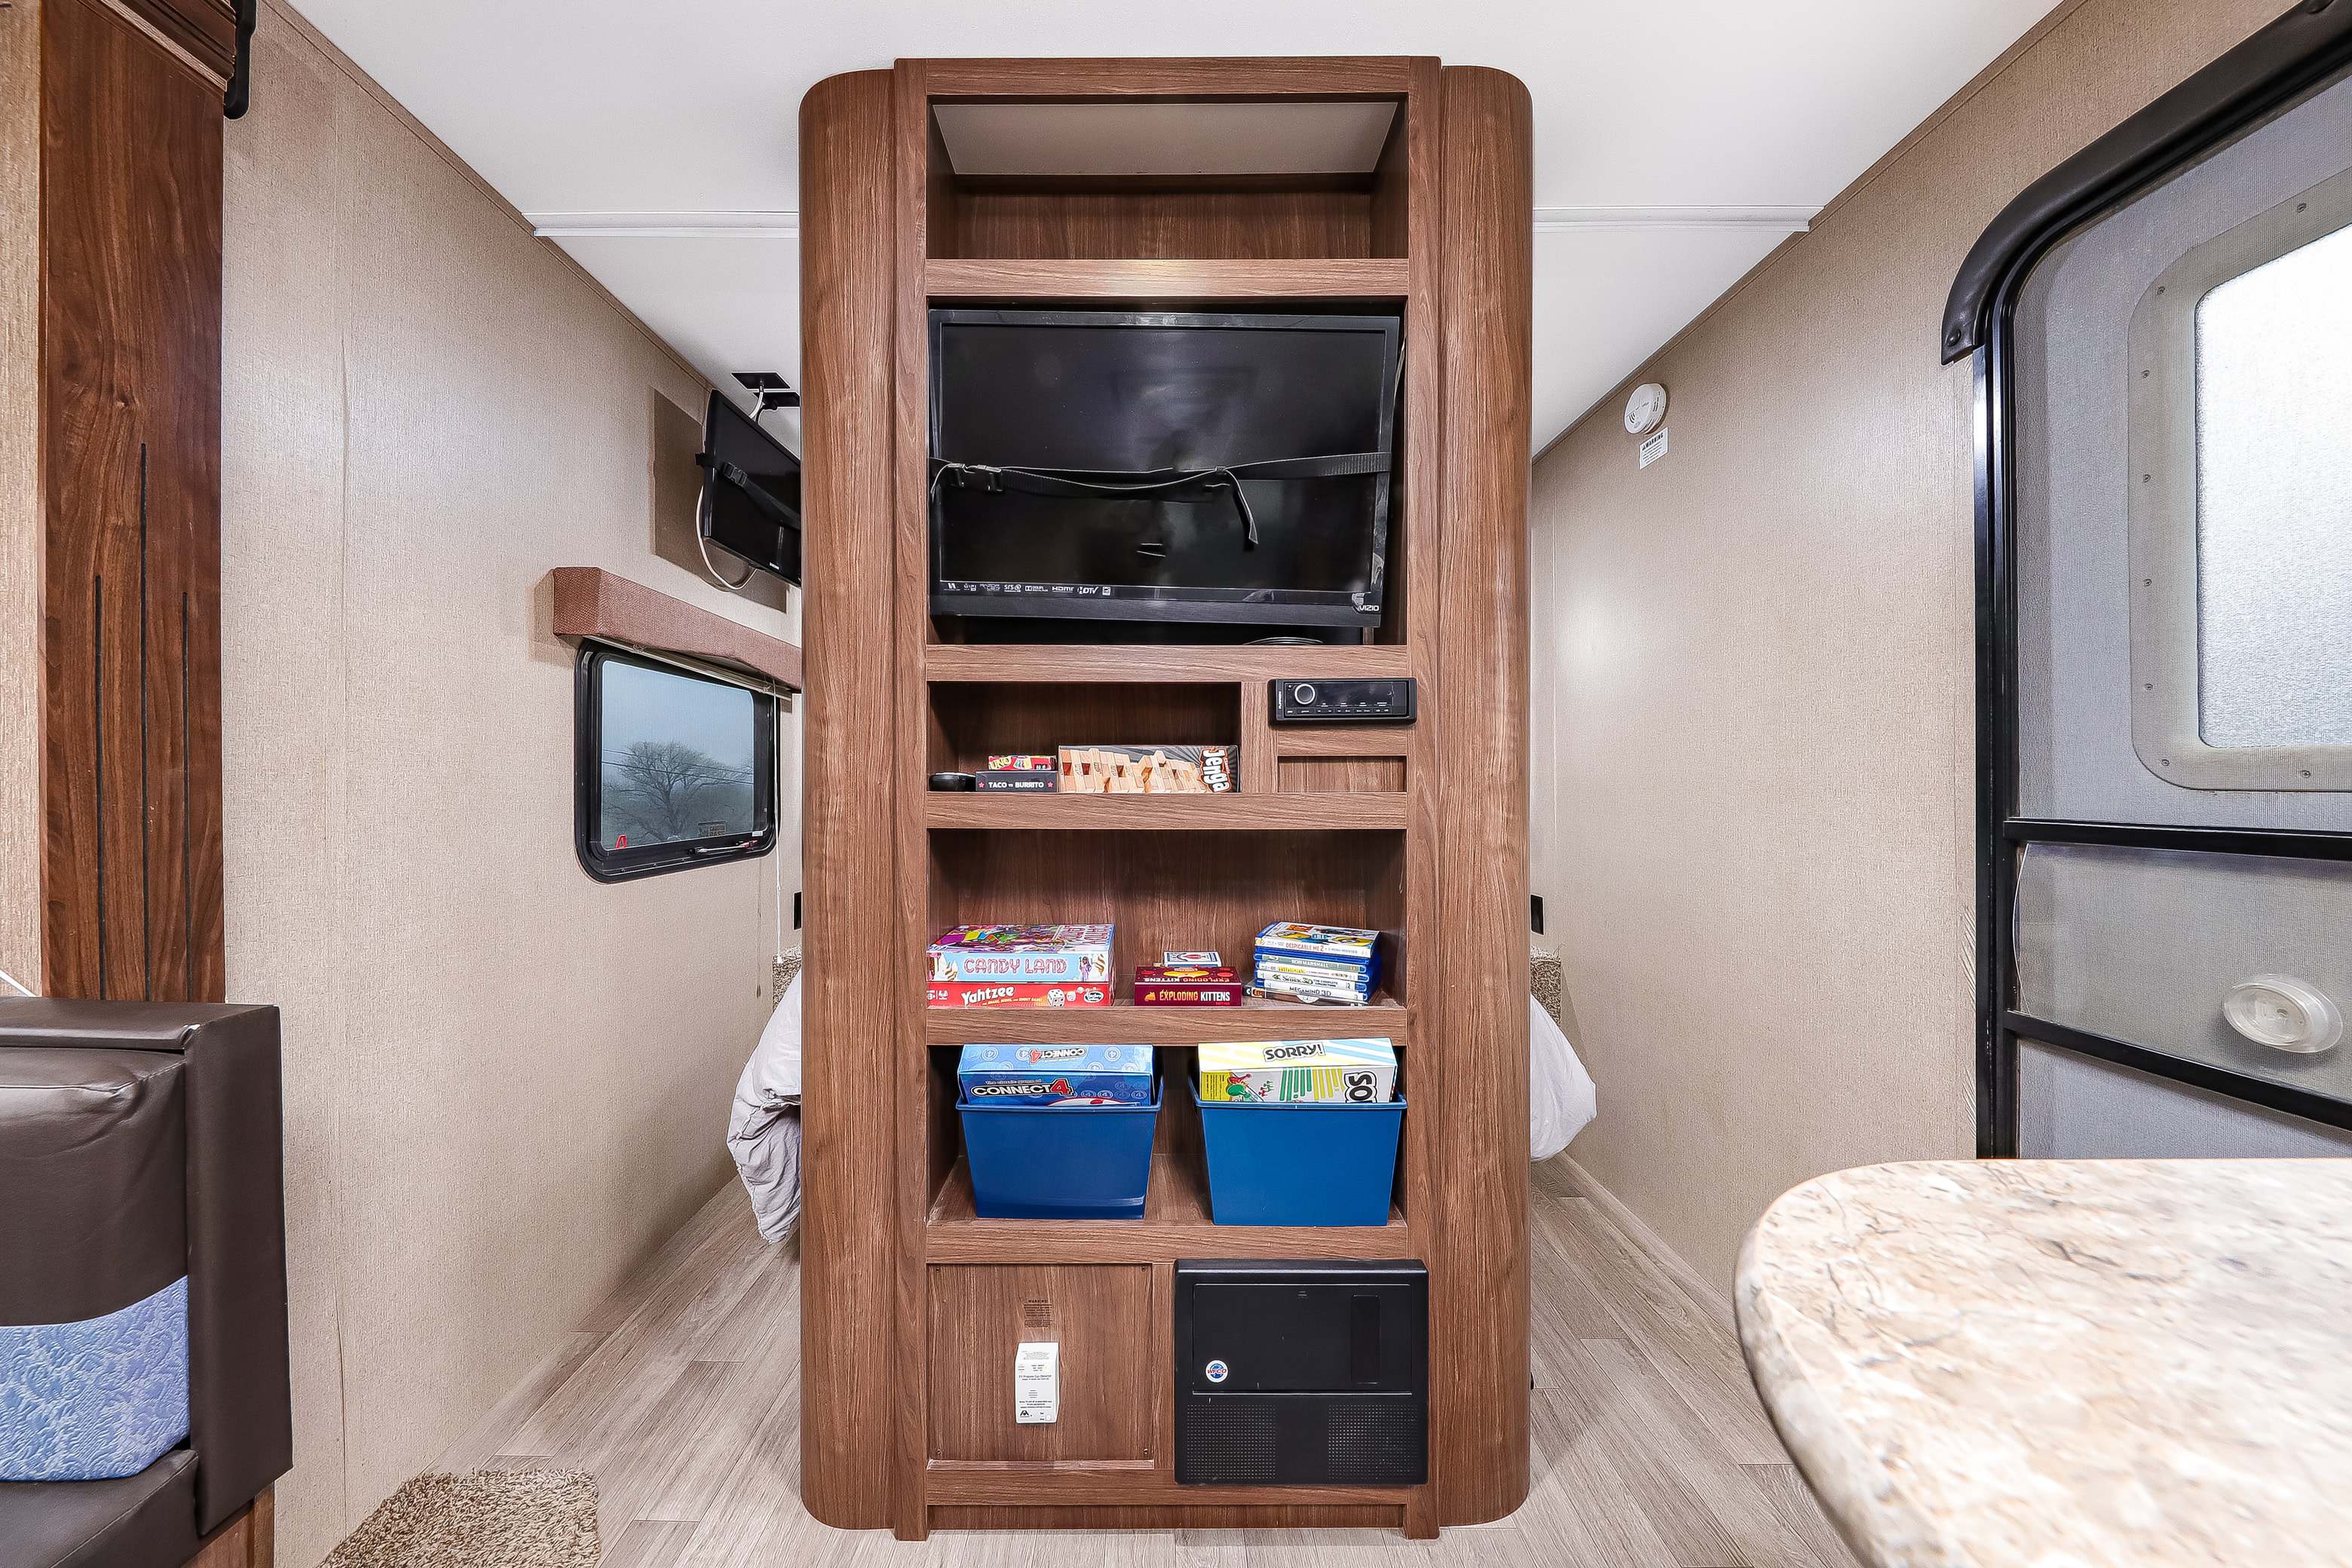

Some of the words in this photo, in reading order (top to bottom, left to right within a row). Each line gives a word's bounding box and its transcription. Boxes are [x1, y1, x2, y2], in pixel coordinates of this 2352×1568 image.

[1645, 432, 1664, 449] WARNING
[988, 757, 1012, 770] UNO
[1202, 749, 1231, 793] Jenga
[1285, 942, 1312, 951] DESPICABLE
[963, 958, 1021, 974] CANDY
[1024, 958, 1067, 974] LAND
[961, 986, 1015, 1006] Yahtzee
[1159, 991, 1199, 1001] EXPLODING
[1200, 991, 1231, 1002] KITTENS
[1289, 986, 1320, 994] MEGAMIND
[1031, 1050, 1042, 1062] 4
[1040, 1048, 1086, 1059] CONNECT
[1265, 1043, 1324, 1061] SORRY!
[973, 1084, 1051, 1095] CONNECT
[1050, 1079, 1070, 1095] 4
[1348, 1073, 1373, 1103] SO
